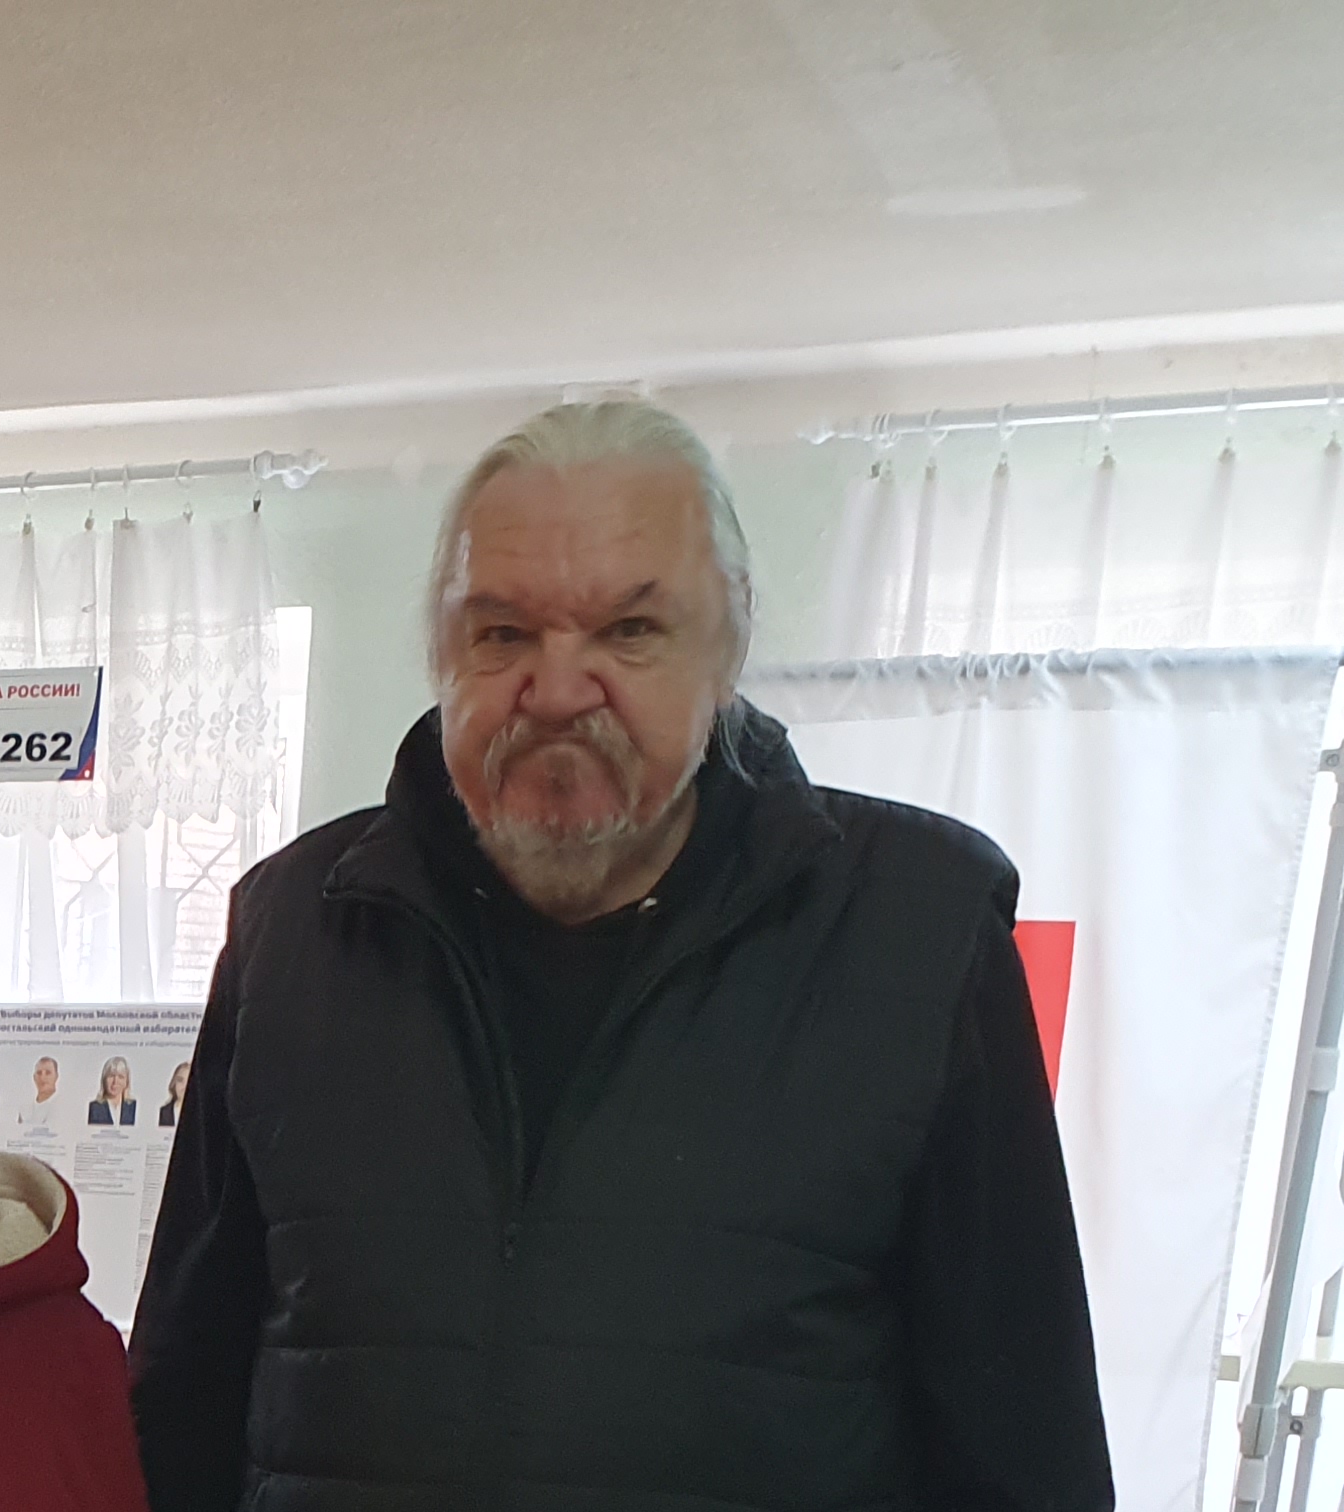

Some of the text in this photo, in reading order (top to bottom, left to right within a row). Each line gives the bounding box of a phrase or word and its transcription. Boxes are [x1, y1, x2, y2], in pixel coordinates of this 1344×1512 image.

[7, 682, 81, 699] РОССИИ!
[0, 1009, 42, 1021] Выборы
[96, 1009, 159, 1020] Московской
